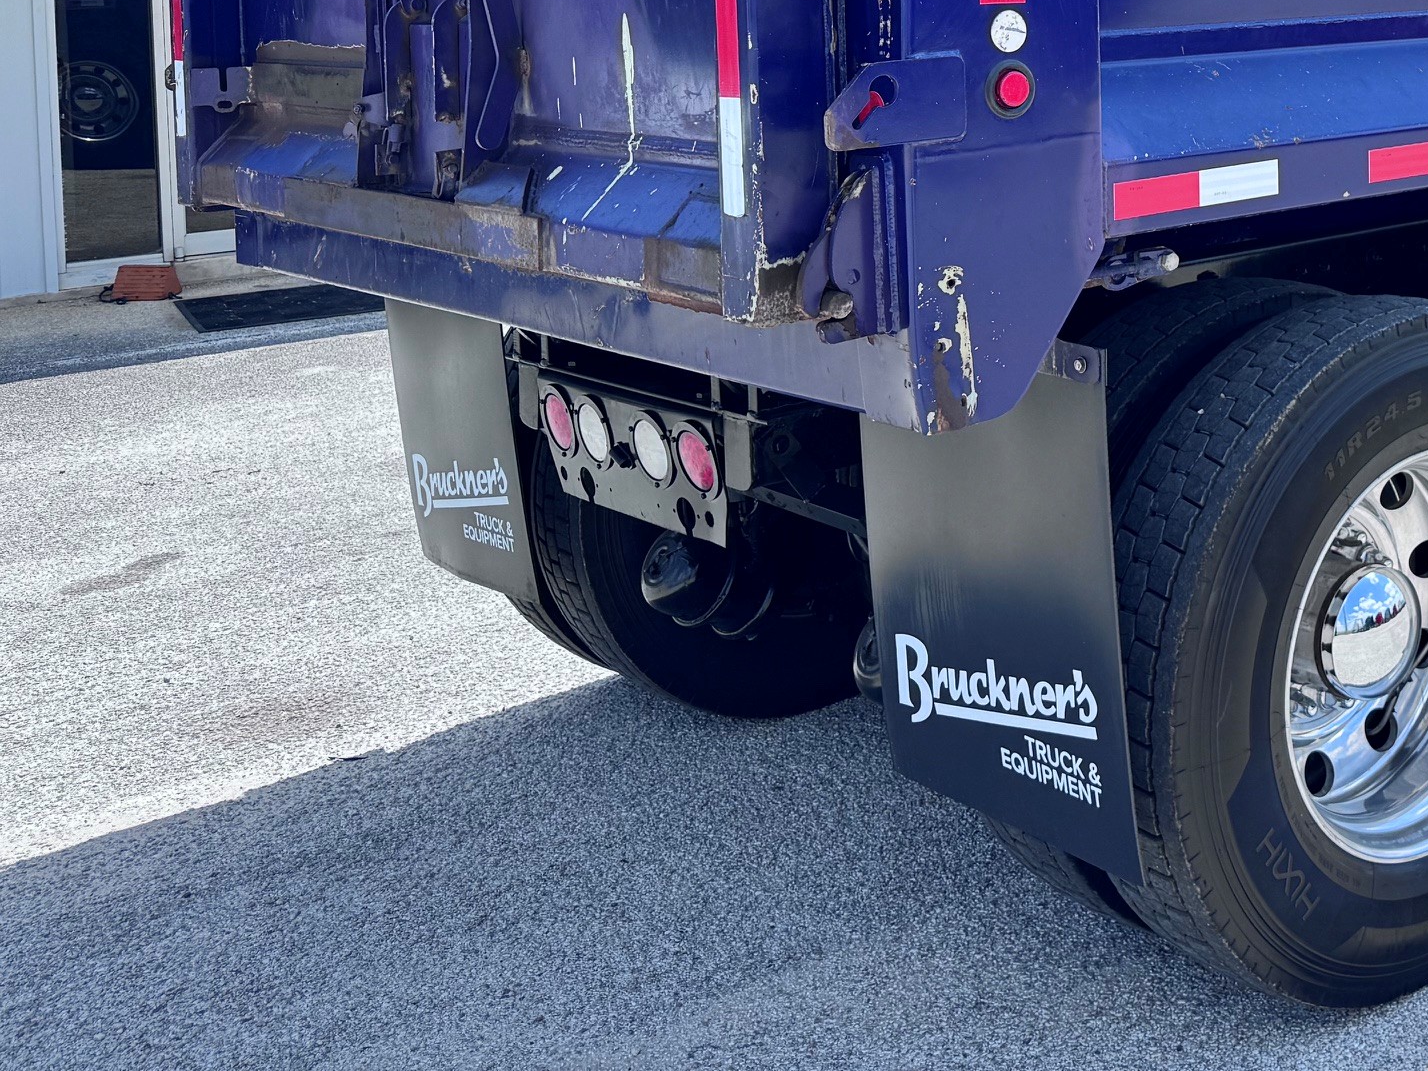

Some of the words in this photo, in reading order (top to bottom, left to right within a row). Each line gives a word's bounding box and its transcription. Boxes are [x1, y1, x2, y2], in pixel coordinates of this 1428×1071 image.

[1324, 390, 1423, 481] 11R24.5
[412, 453, 508, 518] Bruckner's
[463, 523, 515, 553] EQUIPMENT
[474, 511, 505, 534] TRUCK
[506, 521, 514, 537] &
[895, 633, 1098, 723] Bruckner's
[1000, 746, 1102, 808] EQUIPMENT
[1024, 734, 1085, 779] TRUCK
[1088, 762, 1102, 786] &
